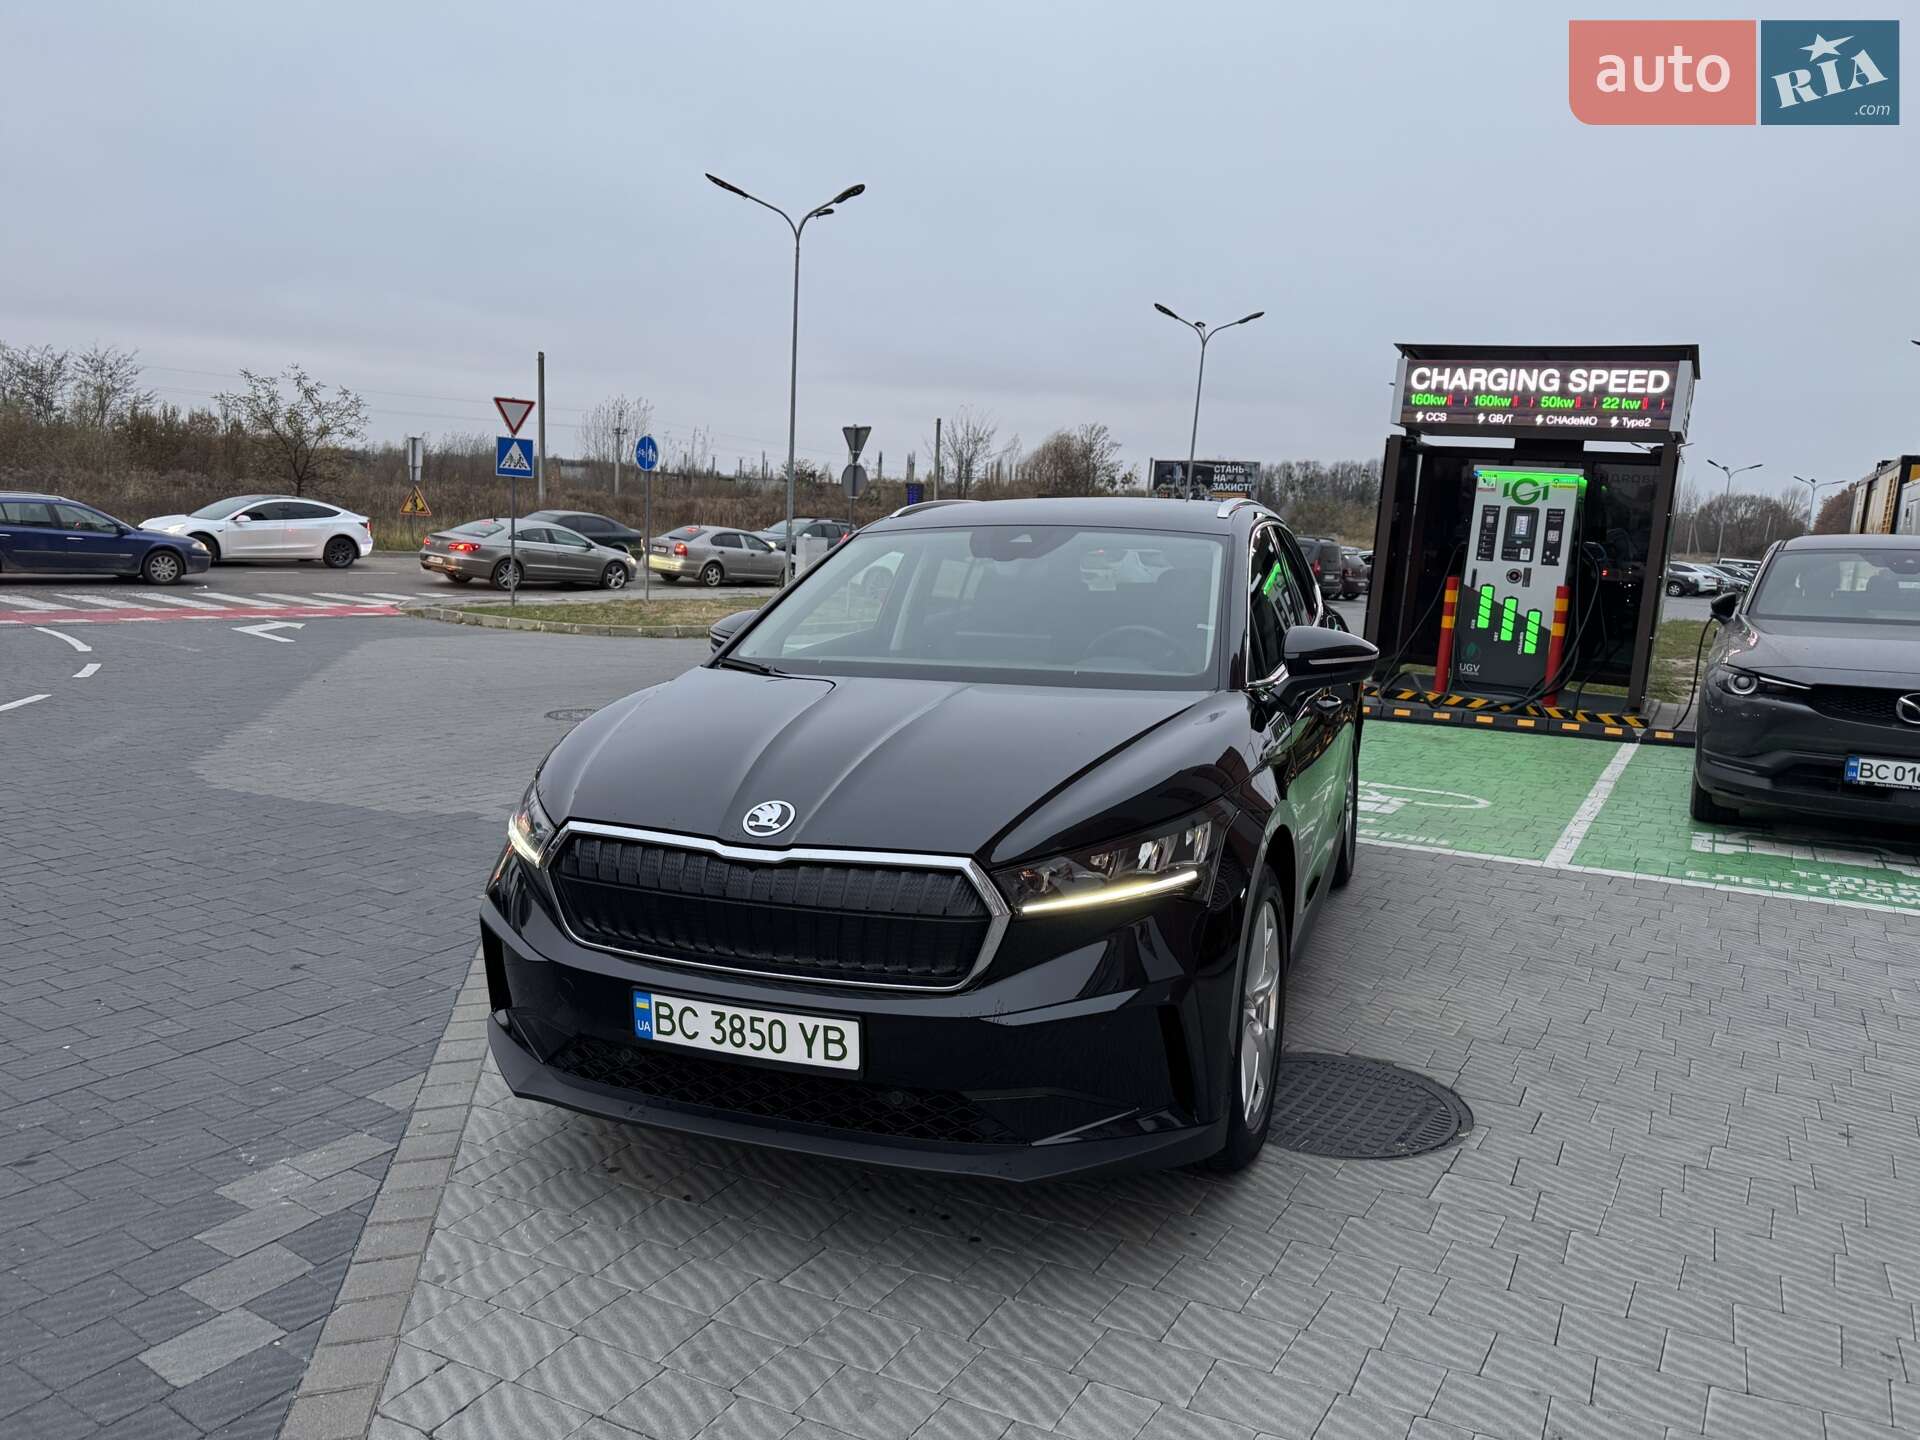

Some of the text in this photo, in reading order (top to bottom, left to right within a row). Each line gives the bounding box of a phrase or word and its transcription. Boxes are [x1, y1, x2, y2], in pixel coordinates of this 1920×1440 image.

[1410, 366, 1670, 394] CHARGING SPEED
[1425, 411, 1651, 428] CCS GB/T CHAdeMO Type2
[1214, 464, 1245, 474] СТАНЬ
[1213, 474, 1226, 482] НА
[1459, 663, 1480, 672] UGV
[1859, 762, 1920, 783] BC 01
[638, 1020, 651, 1032] UA
[655, 1001, 848, 1061] BC 3850 YB
